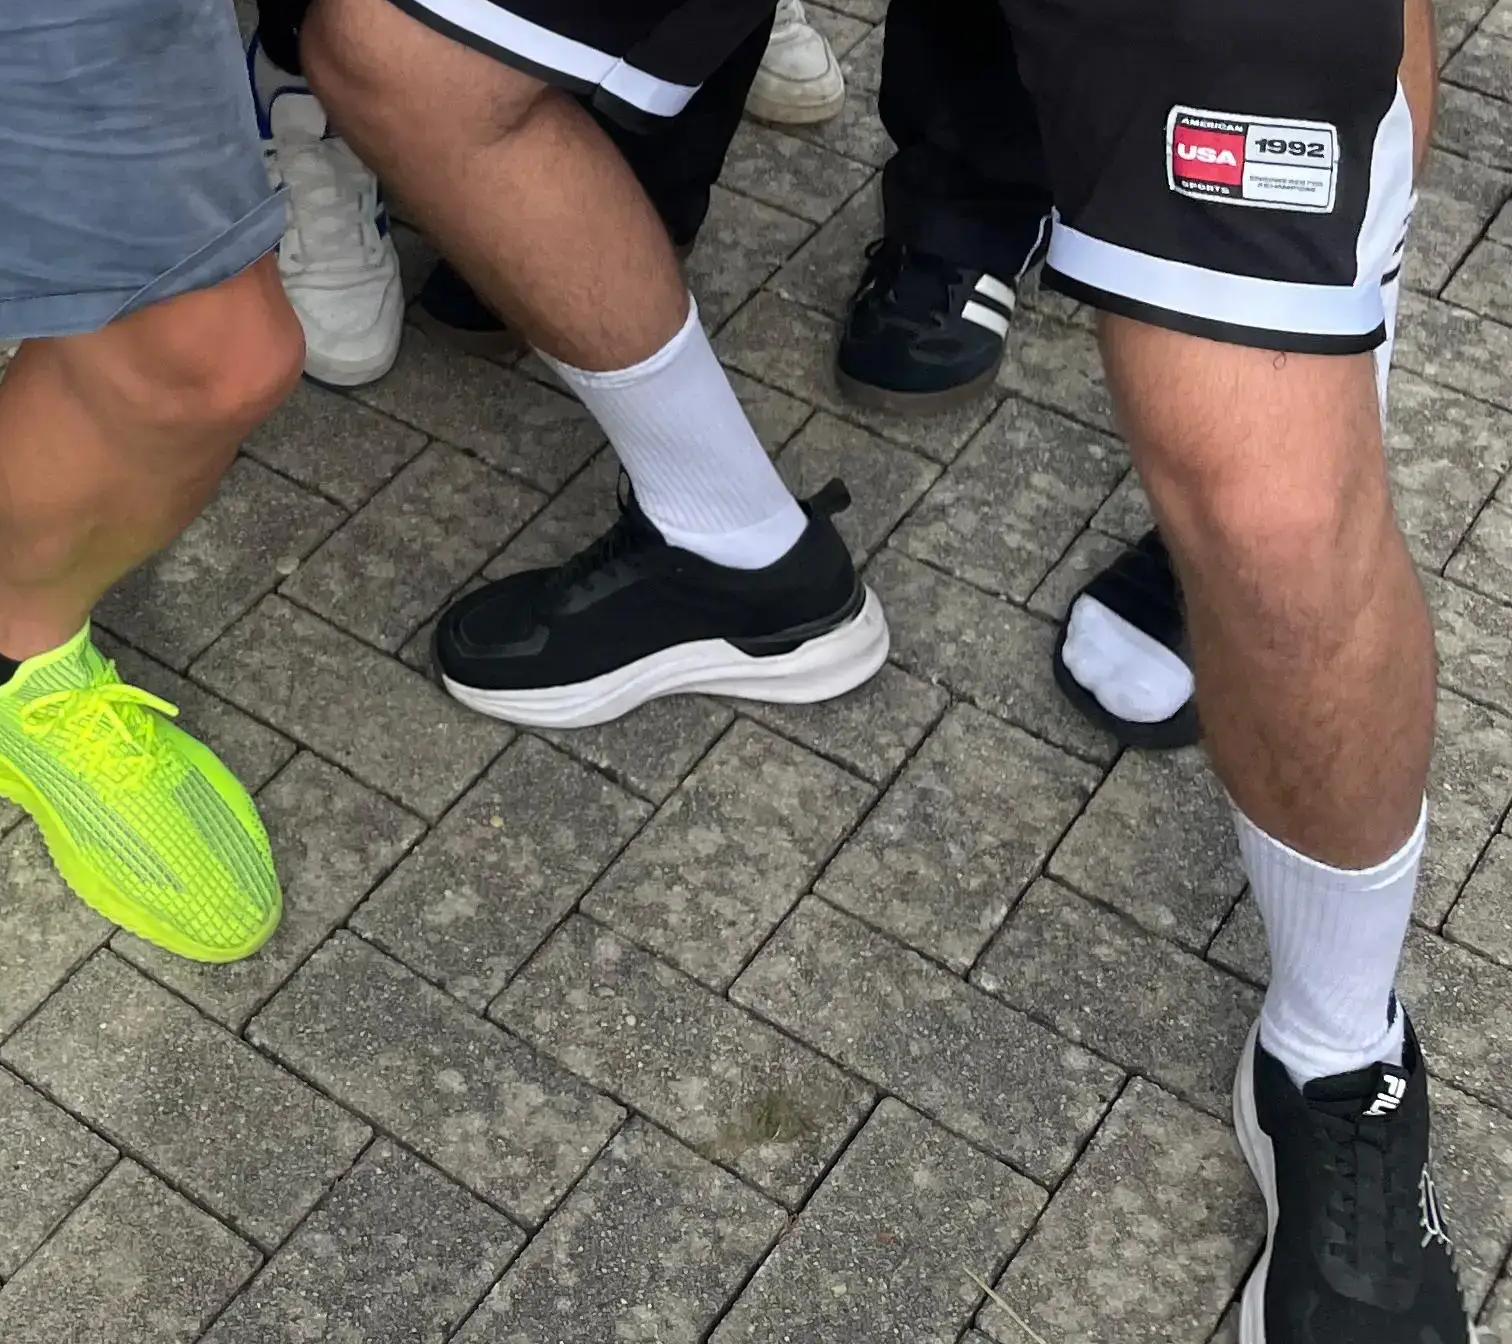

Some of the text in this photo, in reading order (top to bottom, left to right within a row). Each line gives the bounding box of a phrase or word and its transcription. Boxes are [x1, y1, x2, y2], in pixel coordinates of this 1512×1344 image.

[1181, 117, 1244, 133] AMERICAN
[1177, 143, 1237, 167] USA
[1254, 138, 1326, 159] 1992
[1181, 180, 1230, 195] SPORTS
